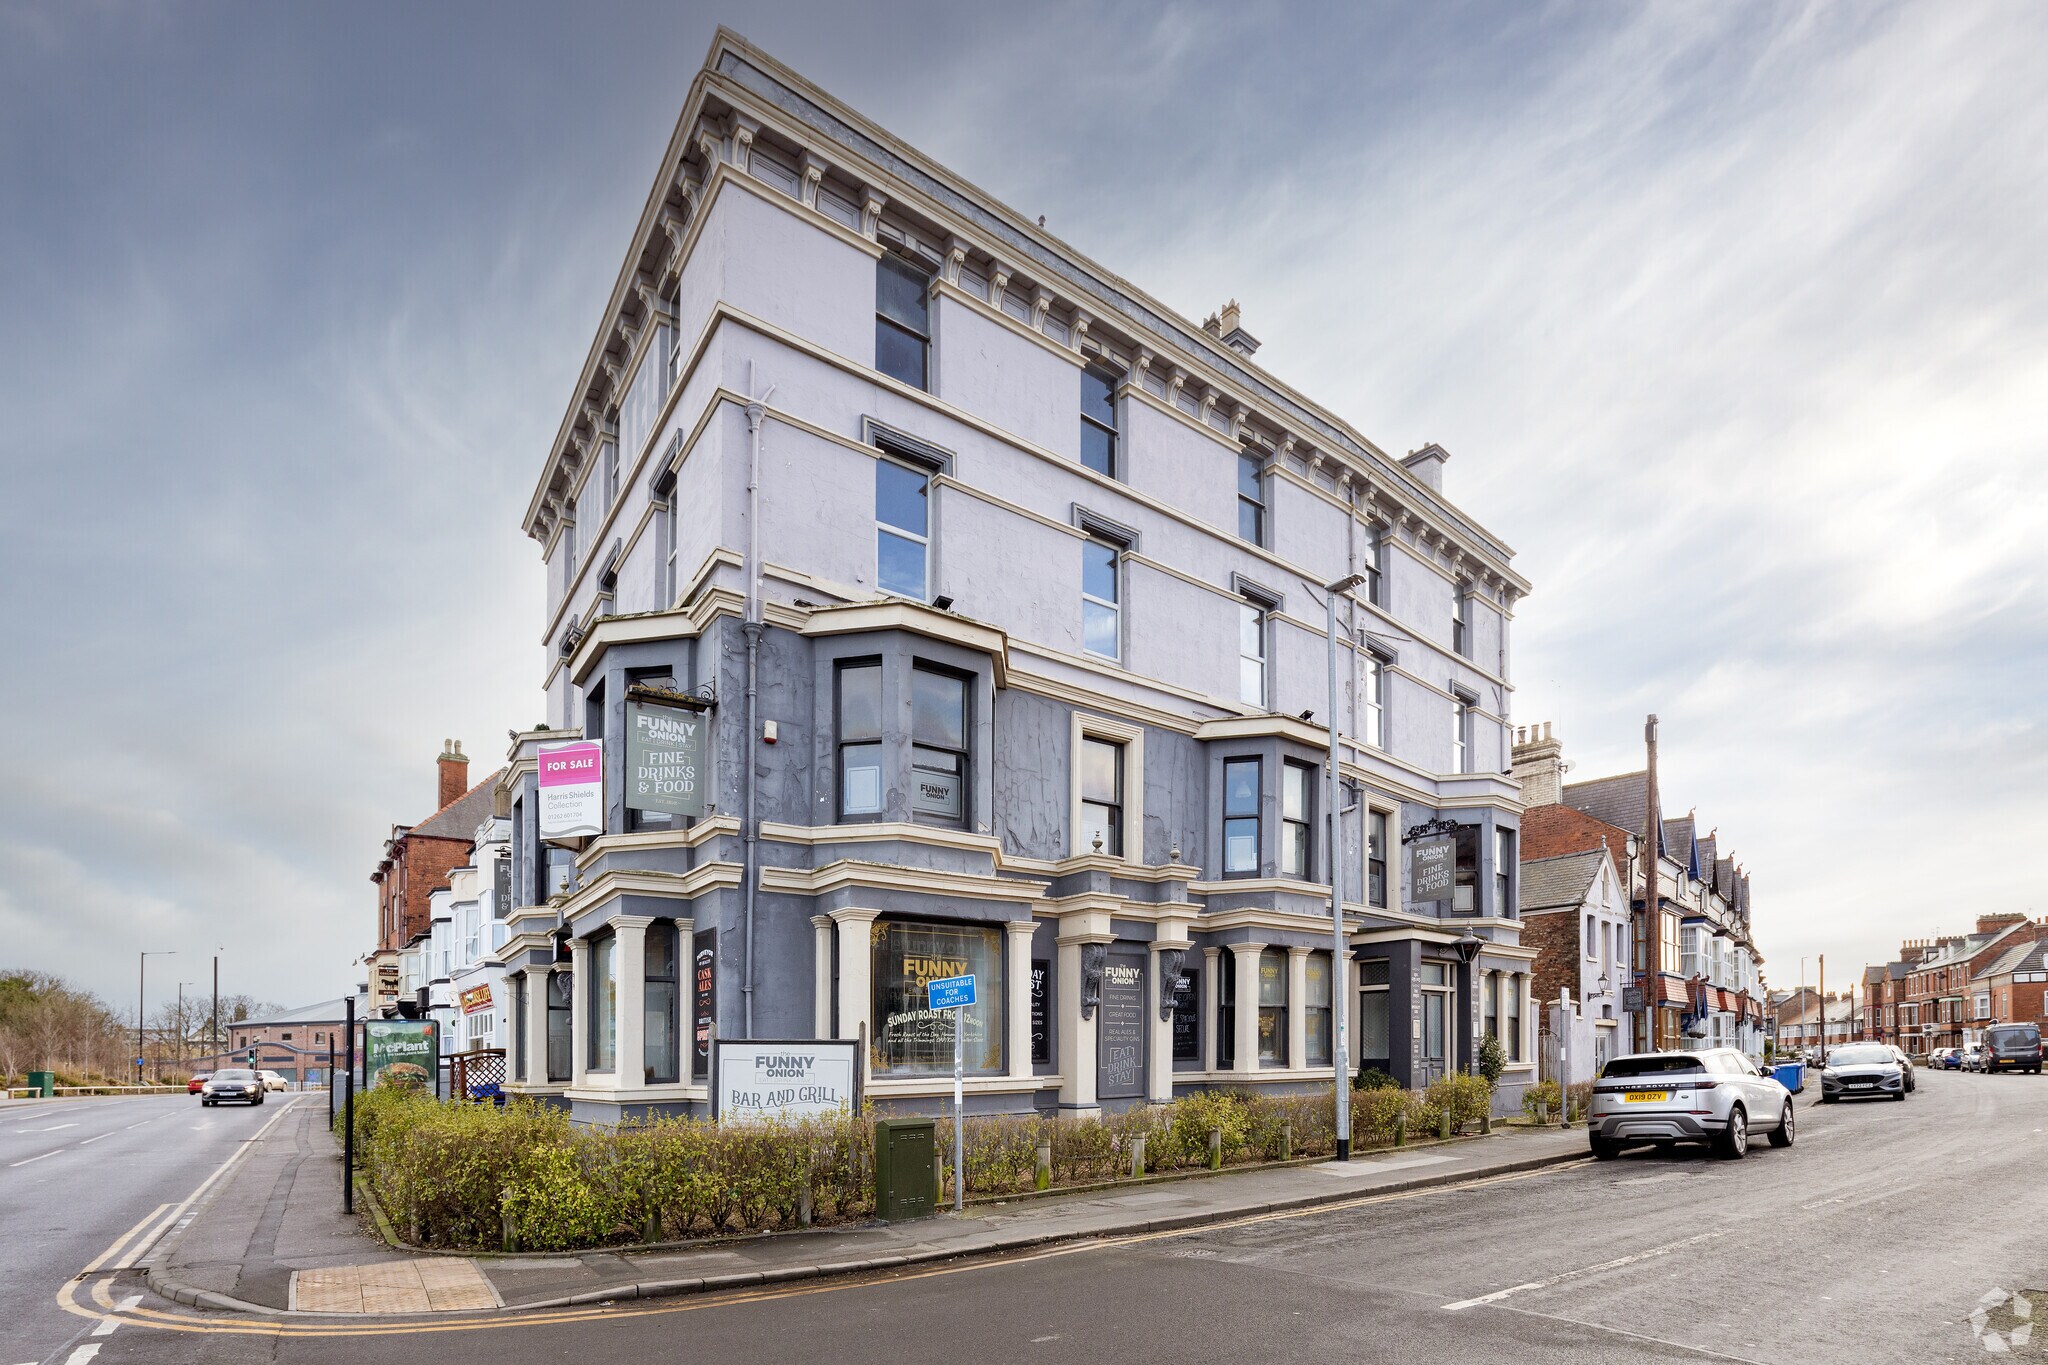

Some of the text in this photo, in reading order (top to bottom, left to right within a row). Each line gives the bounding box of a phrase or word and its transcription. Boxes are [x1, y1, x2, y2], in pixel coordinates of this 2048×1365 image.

[637, 715, 696, 736] FUNNY
[648, 730, 686, 743] ONION
[649, 751, 685, 765] FINE
[547, 759, 593, 771] FOR SALE
[638, 765, 695, 782] DRINKS
[638, 780, 694, 794] & FOOD
[920, 783, 949, 796] FUNNY
[547, 790, 594, 800] Harris Shields
[926, 792, 945, 800] ONION
[548, 801, 582, 810] Collection
[1416, 845, 1449, 857] FUNNY
[1422, 853, 1444, 861] ONION
[1423, 863, 1443, 876] FINE
[1417, 870, 1449, 886] DRINKS
[1417, 878, 1449, 894] & FOOD
[698, 967, 711, 980] CASK
[903, 959, 967, 976] FUNNY
[1105, 967, 1140, 978] FUNNY
[697, 980, 711, 991] ALES
[931, 979, 972, 990] UNSUITABLE
[1112, 977, 1134, 985] ONION
[945, 988, 958, 996] FOR
[936, 994, 969, 1005] COACHES
[887, 1011, 916, 1027] SUNDAY
[918, 1009, 941, 1020] ROAST
[373, 1040, 429, 1053] McPlant
[1113, 1046, 1131, 1060] EAT
[755, 1056, 815, 1068] FUNNY
[1108, 1057, 1136, 1073] DRINK
[766, 1069, 804, 1077] ONION
[1109, 1069, 1131, 1085] STAY
[731, 1086, 838, 1109] BAR AND GRILL
